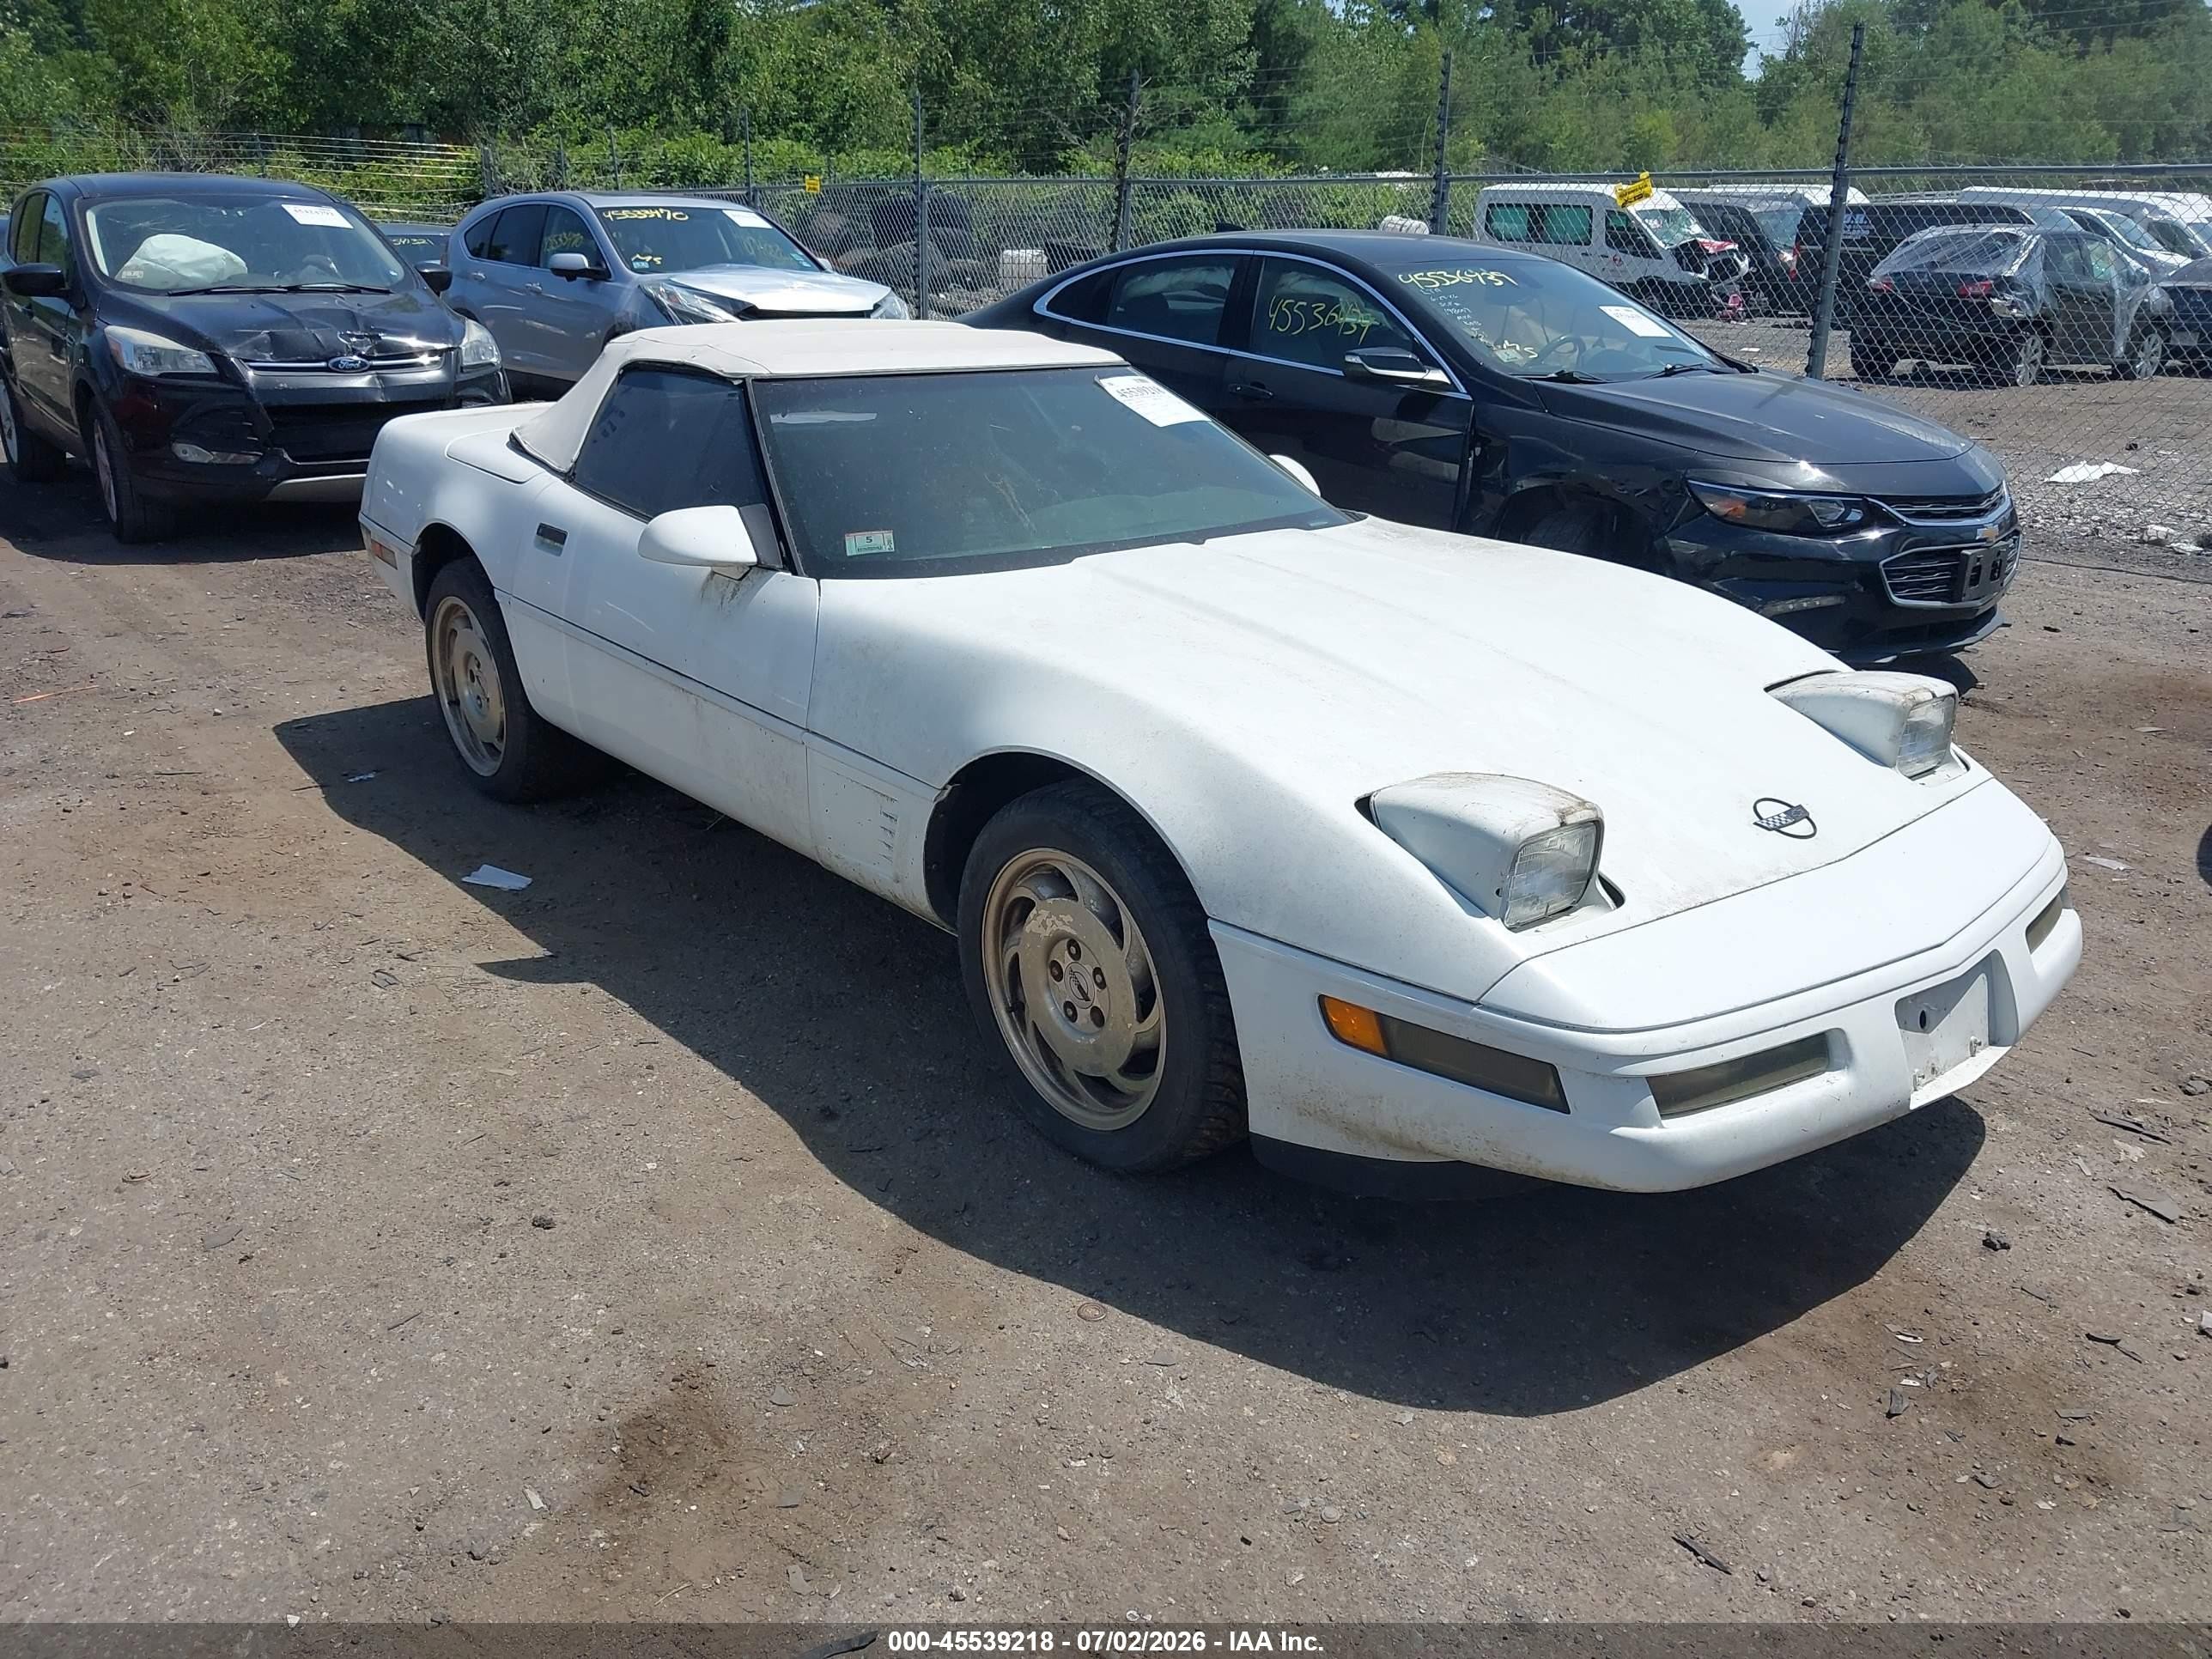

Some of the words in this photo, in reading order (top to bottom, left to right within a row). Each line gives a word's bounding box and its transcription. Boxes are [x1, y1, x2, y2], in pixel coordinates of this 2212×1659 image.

[603, 207, 689, 222] 45533470
[1398, 268, 1519, 289] 45536439
[1269, 295, 1376, 345] 45536439
